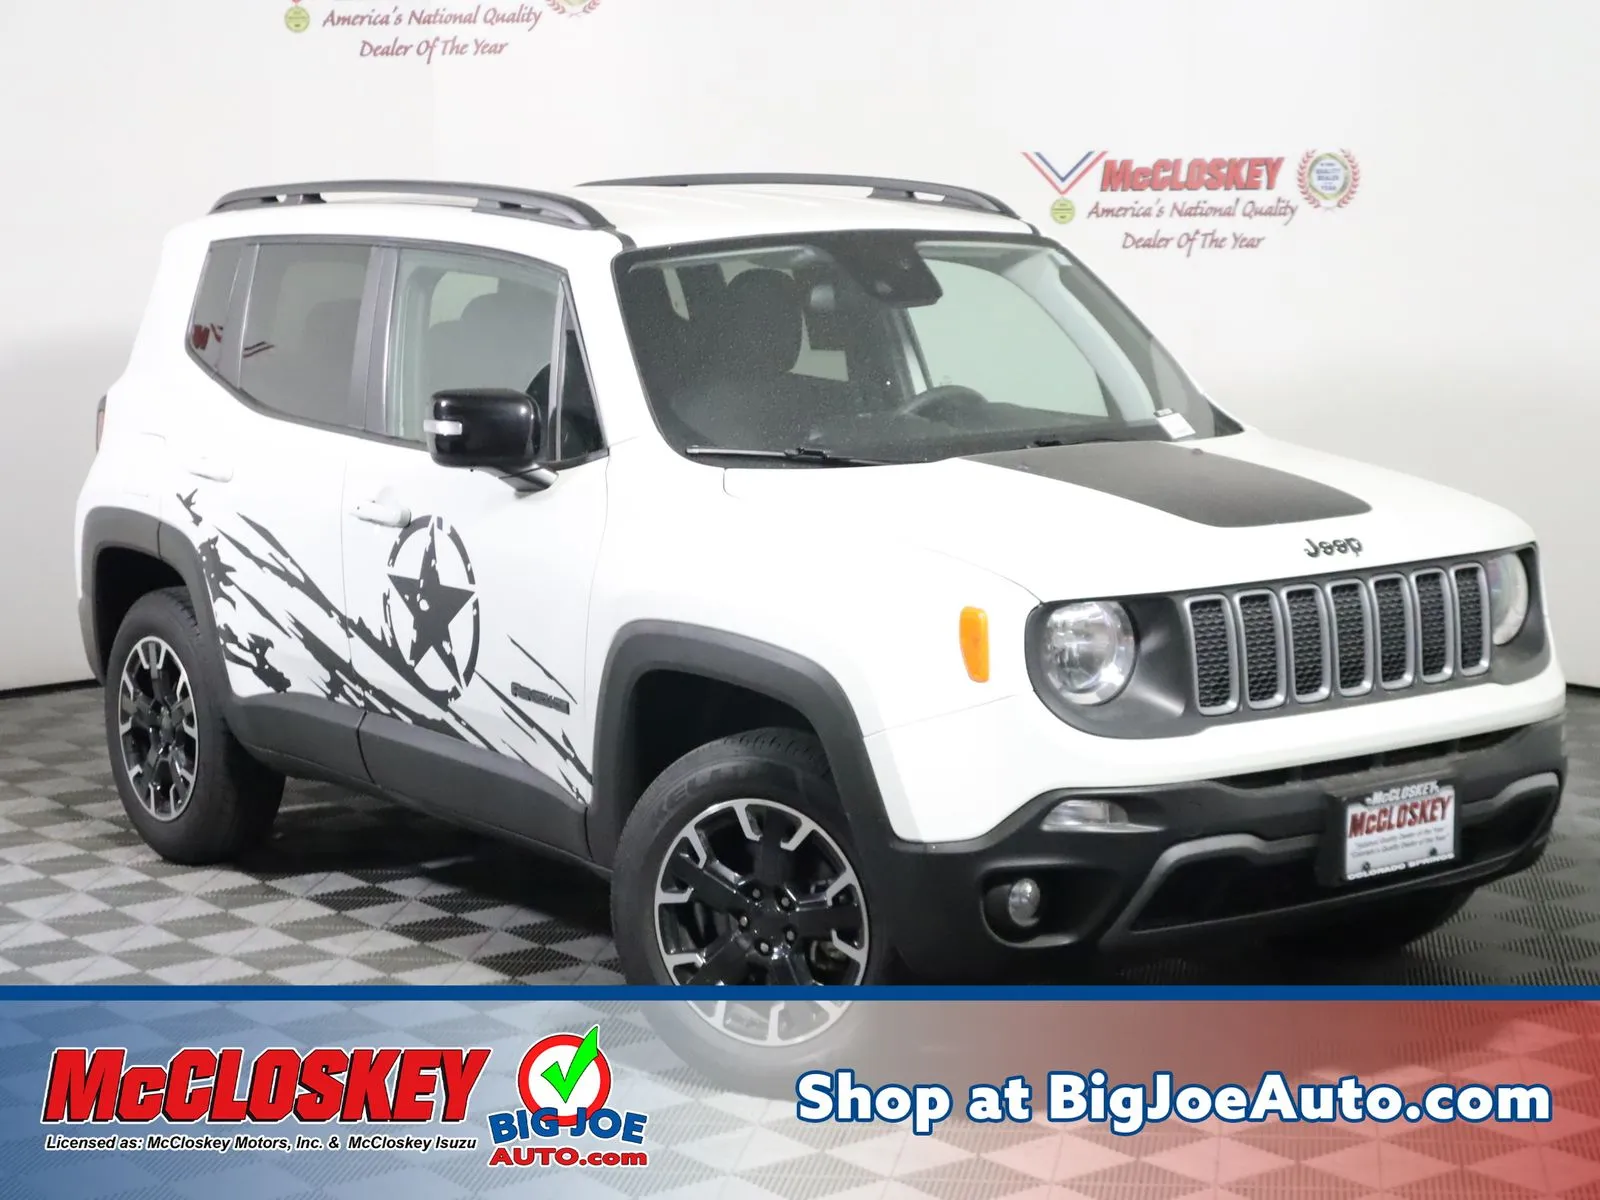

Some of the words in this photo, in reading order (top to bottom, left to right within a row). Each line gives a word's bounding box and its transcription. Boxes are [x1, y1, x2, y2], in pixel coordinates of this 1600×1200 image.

[322, 6, 403, 27] America's
[407, 5, 481, 26] National
[482, 3, 543, 32] Quality
[359, 36, 414, 58] Dealer
[416, 36, 440, 65] Of
[441, 35, 468, 55] The
[472, 38, 508, 55] Year
[1100, 157, 1285, 192] McCLOSKEY
[1087, 198, 1165, 219] America's
[1169, 197, 1240, 218] National
[1242, 196, 1298, 226] Quality
[1121, 229, 1175, 249] Dealer
[1177, 229, 1200, 259] Of
[1201, 229, 1227, 249] The
[1232, 232, 1265, 249] Year
[1304, 537, 1363, 558] Jeep
[1349, 796, 1452, 838] McCLOSKEY
